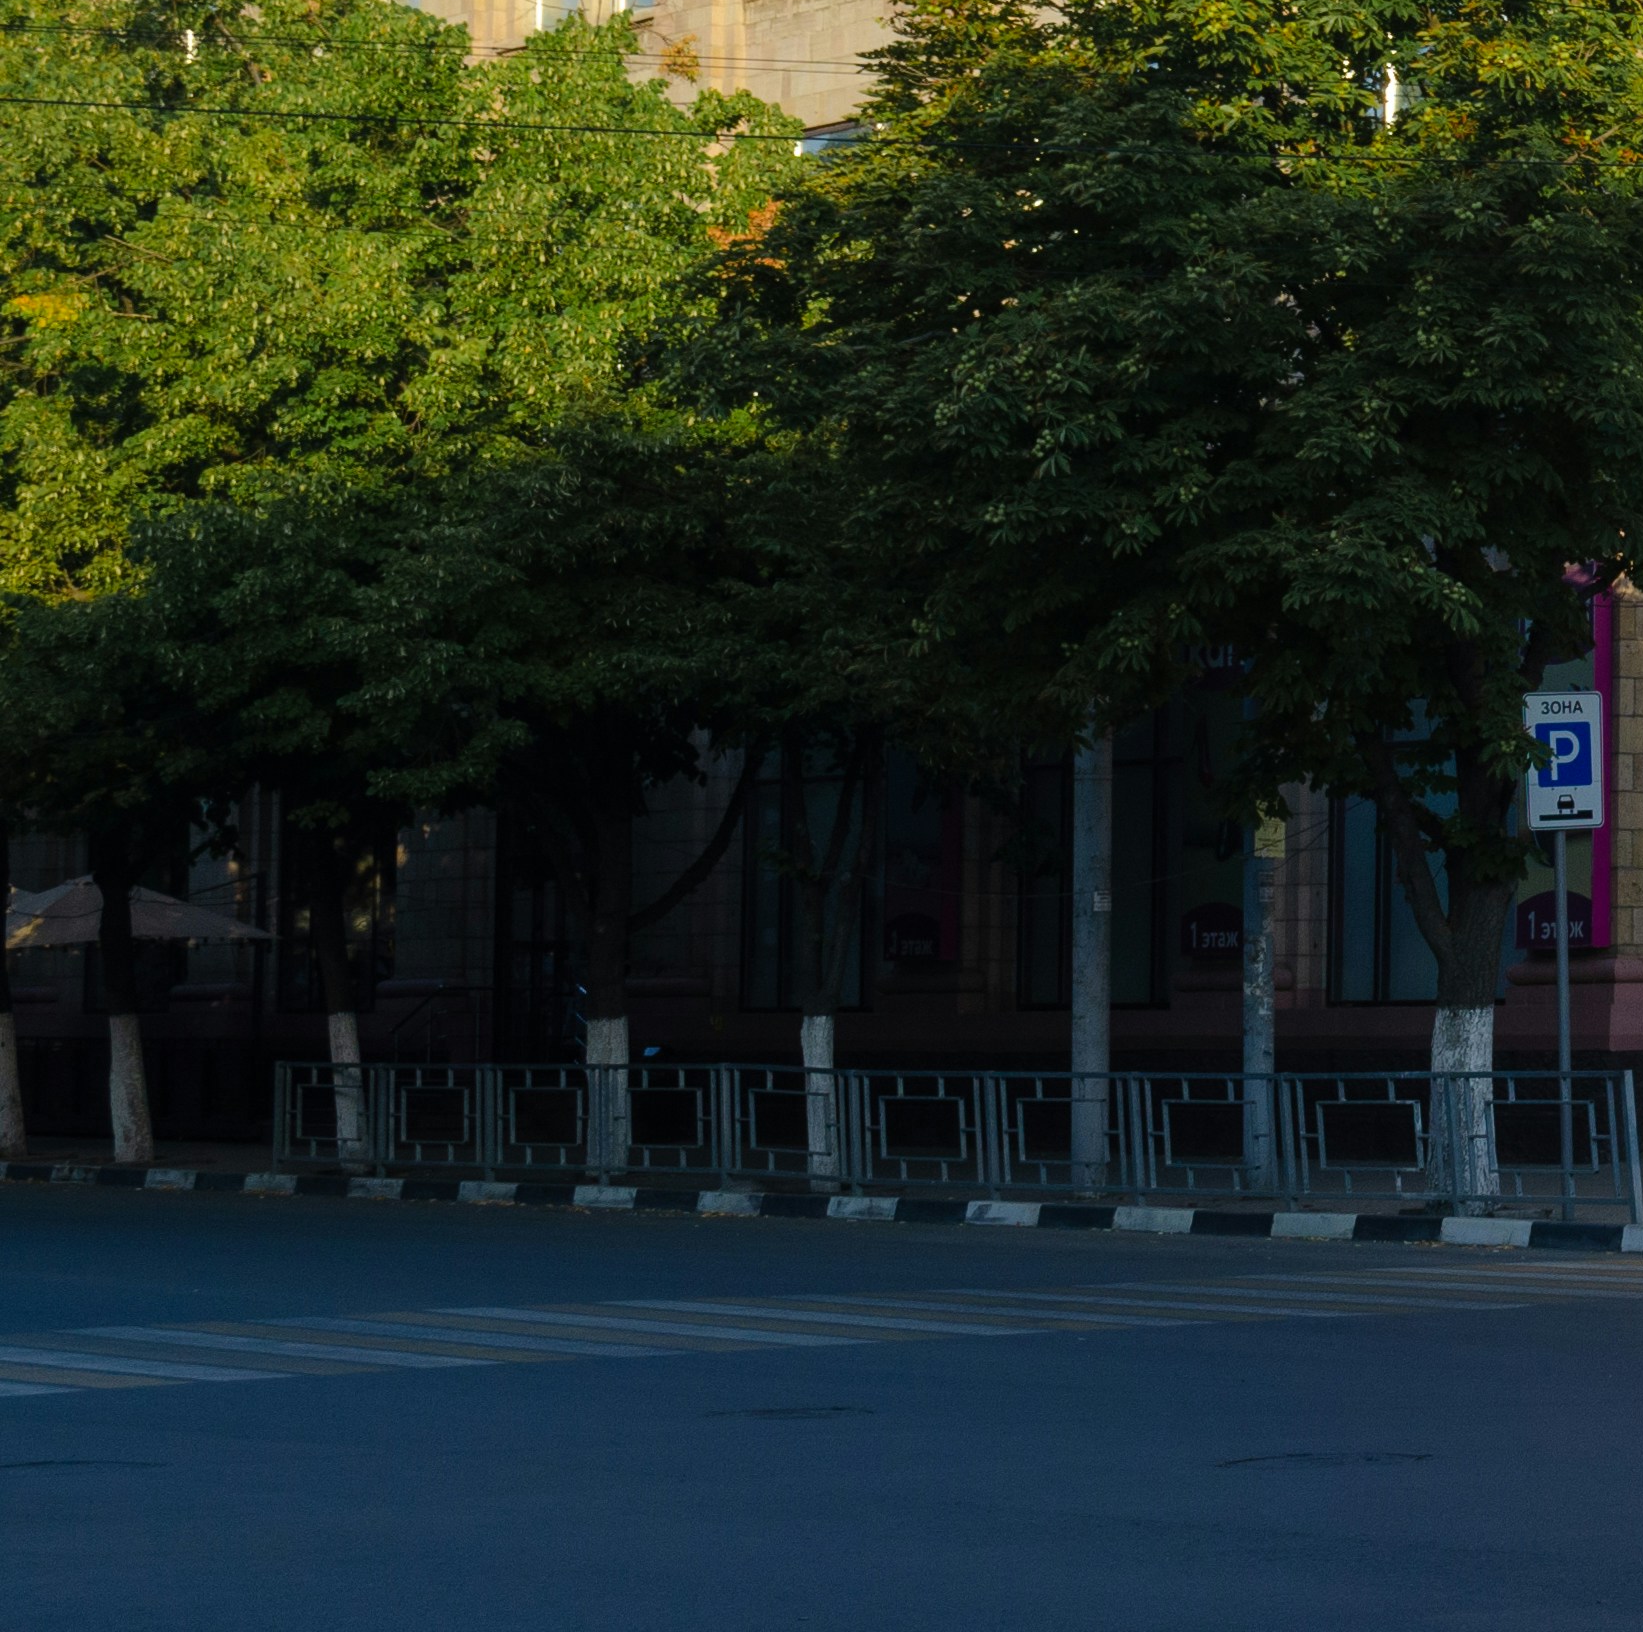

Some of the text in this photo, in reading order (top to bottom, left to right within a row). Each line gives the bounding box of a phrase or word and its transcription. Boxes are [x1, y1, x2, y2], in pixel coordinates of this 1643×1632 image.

[1540, 700, 1583, 715] ЗОНА
[1189, 920, 1239, 949] 1 этаж
[1528, 911, 1584, 941] 1 этж
[900, 939, 933, 956] этаж
